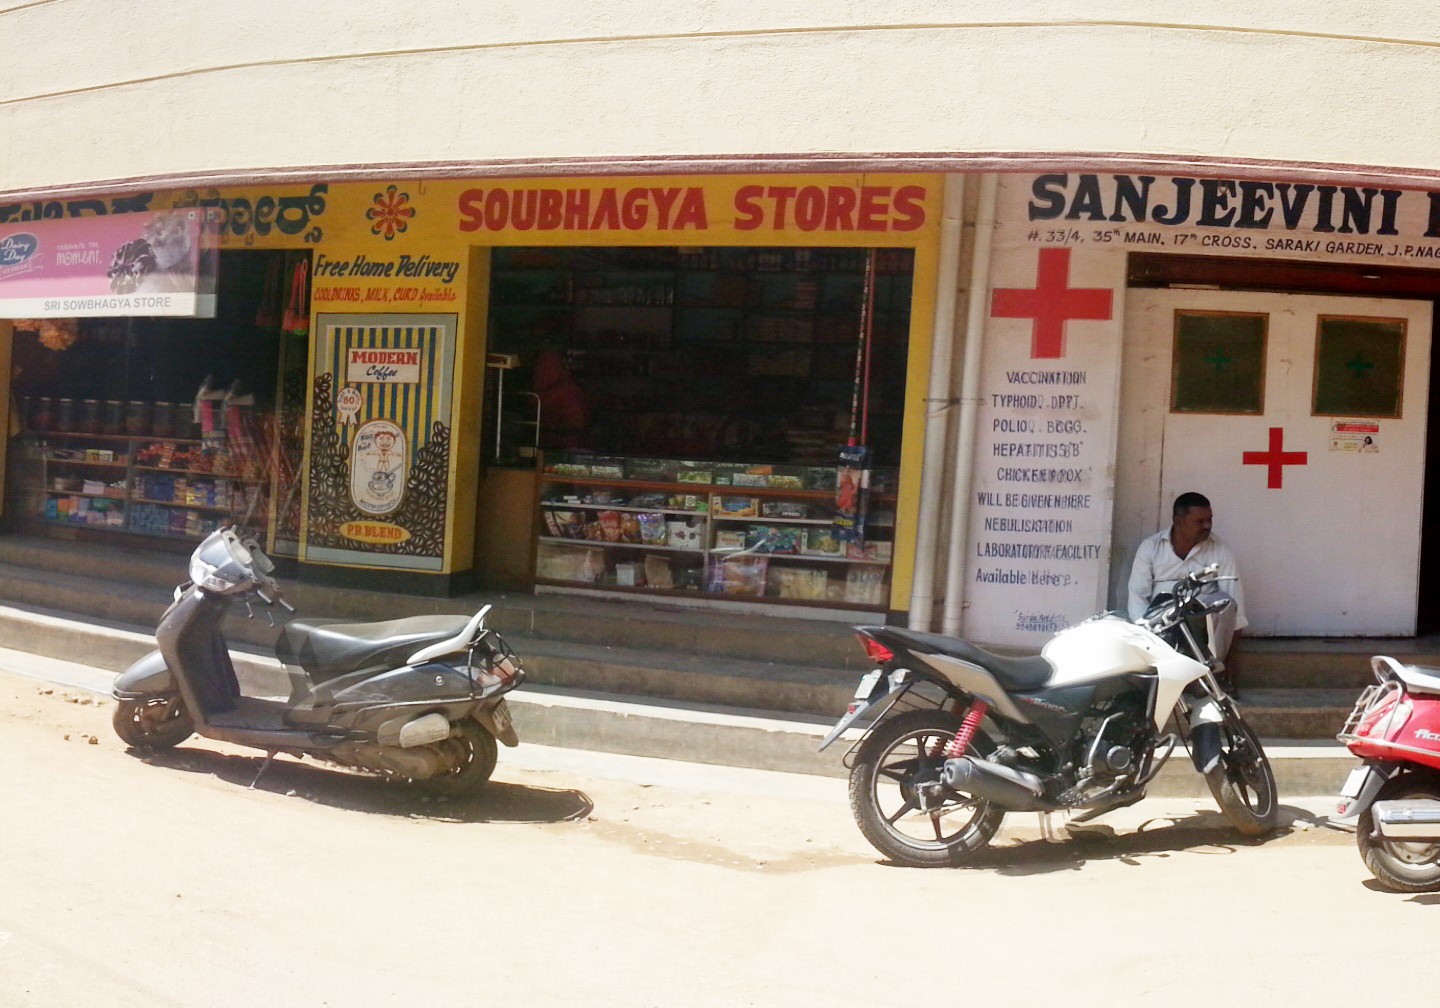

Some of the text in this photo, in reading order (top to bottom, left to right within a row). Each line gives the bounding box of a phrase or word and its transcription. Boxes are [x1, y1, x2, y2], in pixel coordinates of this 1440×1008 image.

[458, 185, 927, 233] SOUBHAGYA STORES
[1028, 172, 1403, 237] SANJEEVINI
[2, 238, 30, 251] Dairy
[1265, 239, 1321, 253] SARAKI
[4, 249, 26, 263] Day
[314, 254, 460, 284] Free Home Delivery
[44, 297, 172, 311] SRI SOWBHAGYA STORE
[350, 350, 419, 366] MODERN
[366, 364, 398, 381] Coffee
[978, 491, 1002, 507] WILL
[363, 526, 402, 539] BLEND
[976, 568, 1027, 585] Available
